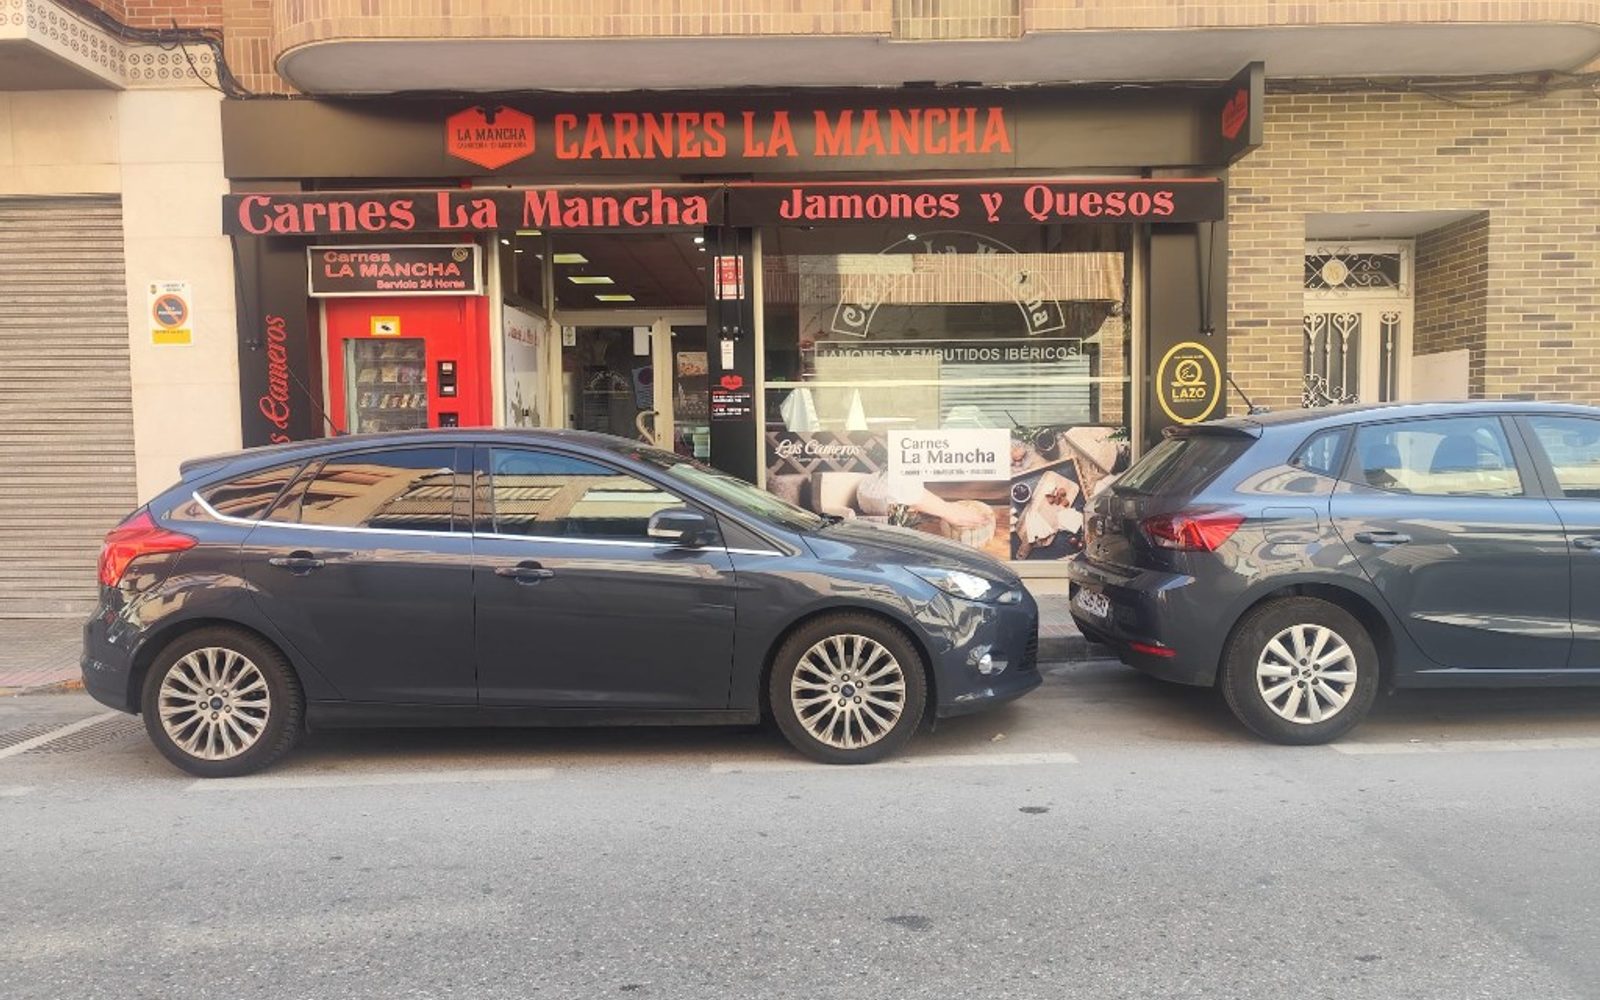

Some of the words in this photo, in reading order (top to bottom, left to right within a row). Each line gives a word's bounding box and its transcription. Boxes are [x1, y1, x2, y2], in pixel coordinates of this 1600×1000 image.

[457, 128, 471, 141] LA
[475, 127, 526, 141] MANCHA
[554, 112, 727, 161] CARNES
[742, 110, 798, 158] LA
[813, 106, 1012, 157] MANCHA
[238, 194, 416, 235] Carnes
[437, 191, 498, 229] La
[522, 188, 709, 228] Mancha
[779, 188, 960, 220] Jamones
[980, 191, 1004, 223] y
[1023, 185, 1175, 220] Quesos
[324, 250, 391, 263] Carnes
[324, 263, 354, 278] LA
[359, 262, 461, 278] MANCHA
[376, 280, 419, 289] Servicio
[420, 279, 433, 288] 24
[435, 279, 466, 288] Horas
[910, 347, 1000, 361] EMBUTIDOS
[1004, 345, 1077, 360] IBÉRICOS
[1172, 387, 1206, 398] LAZO
[900, 437, 950, 450] Carnes
[901, 449, 921, 464] La
[927, 448, 995, 463] Mancha
